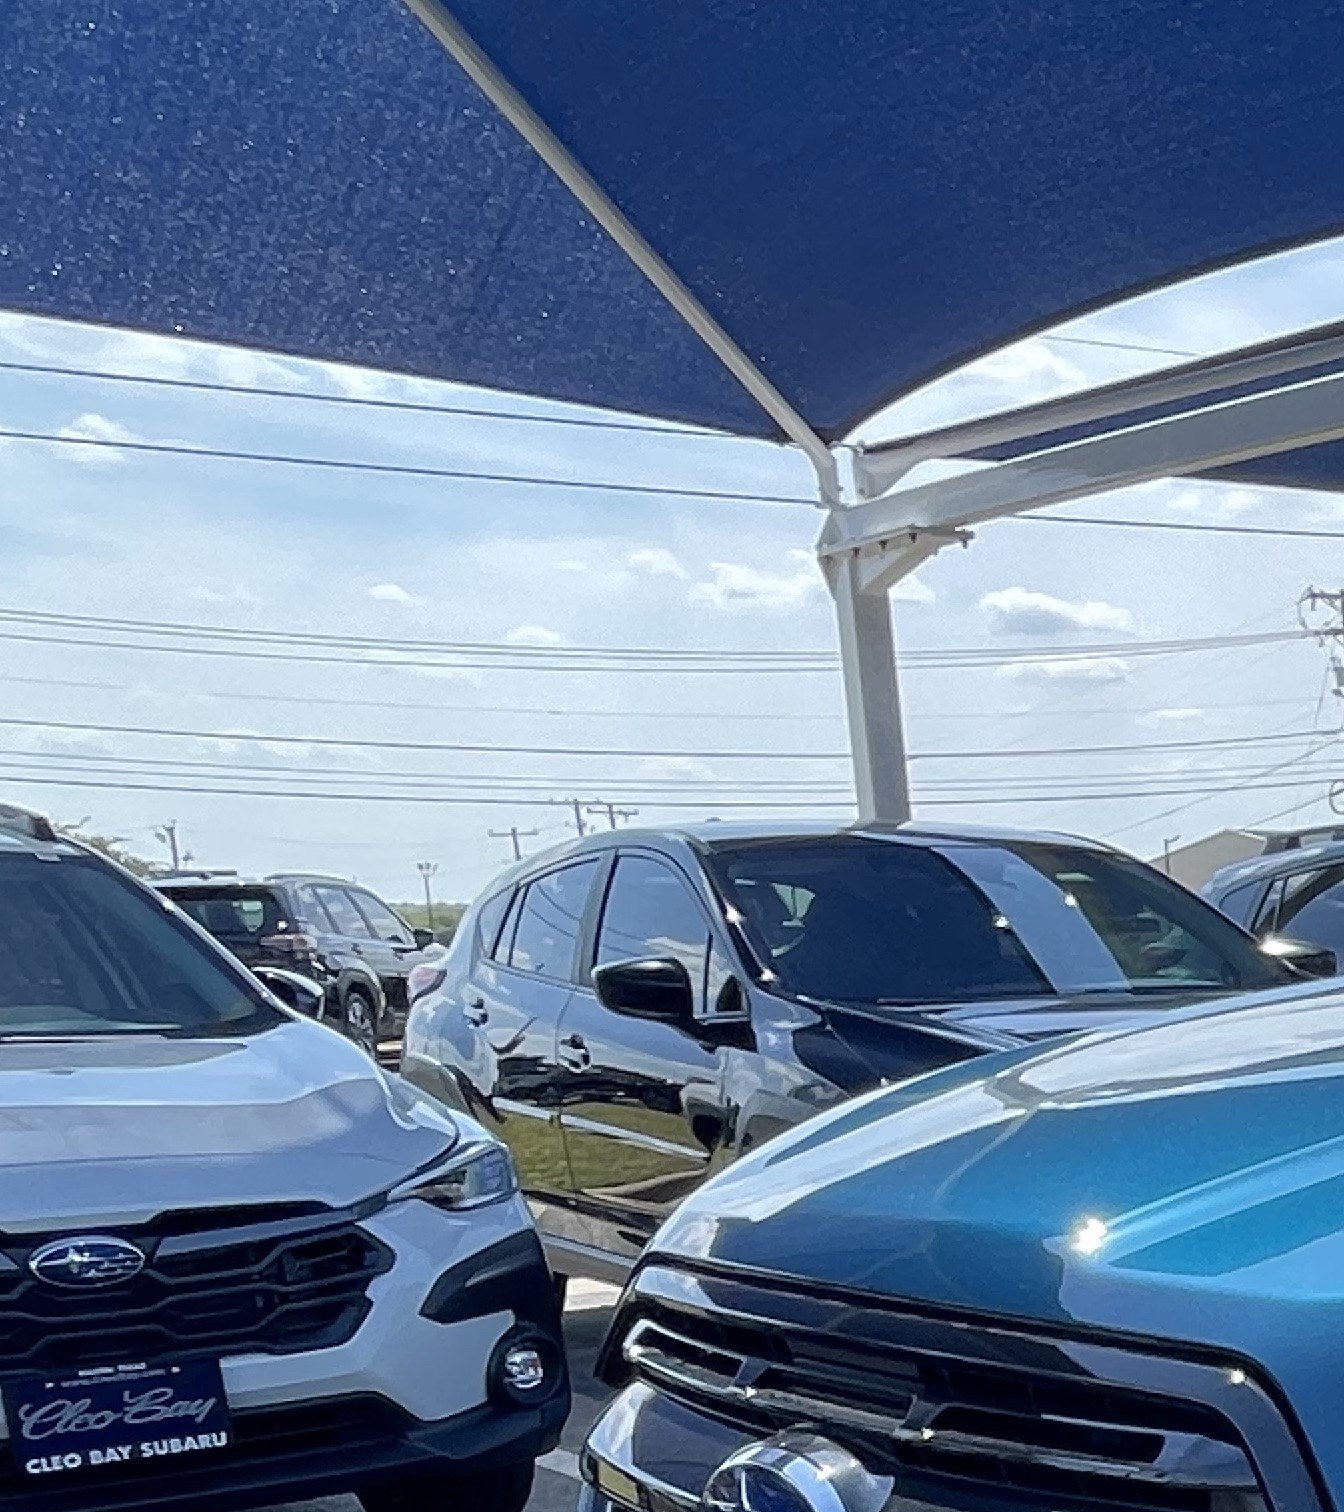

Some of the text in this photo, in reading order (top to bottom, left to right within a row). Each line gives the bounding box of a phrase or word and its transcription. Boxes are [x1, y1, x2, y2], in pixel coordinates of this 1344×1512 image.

[18, 1387, 217, 1440] Cleo Bay
[25, 1431, 229, 1474] CLEO BAY SUBARU
